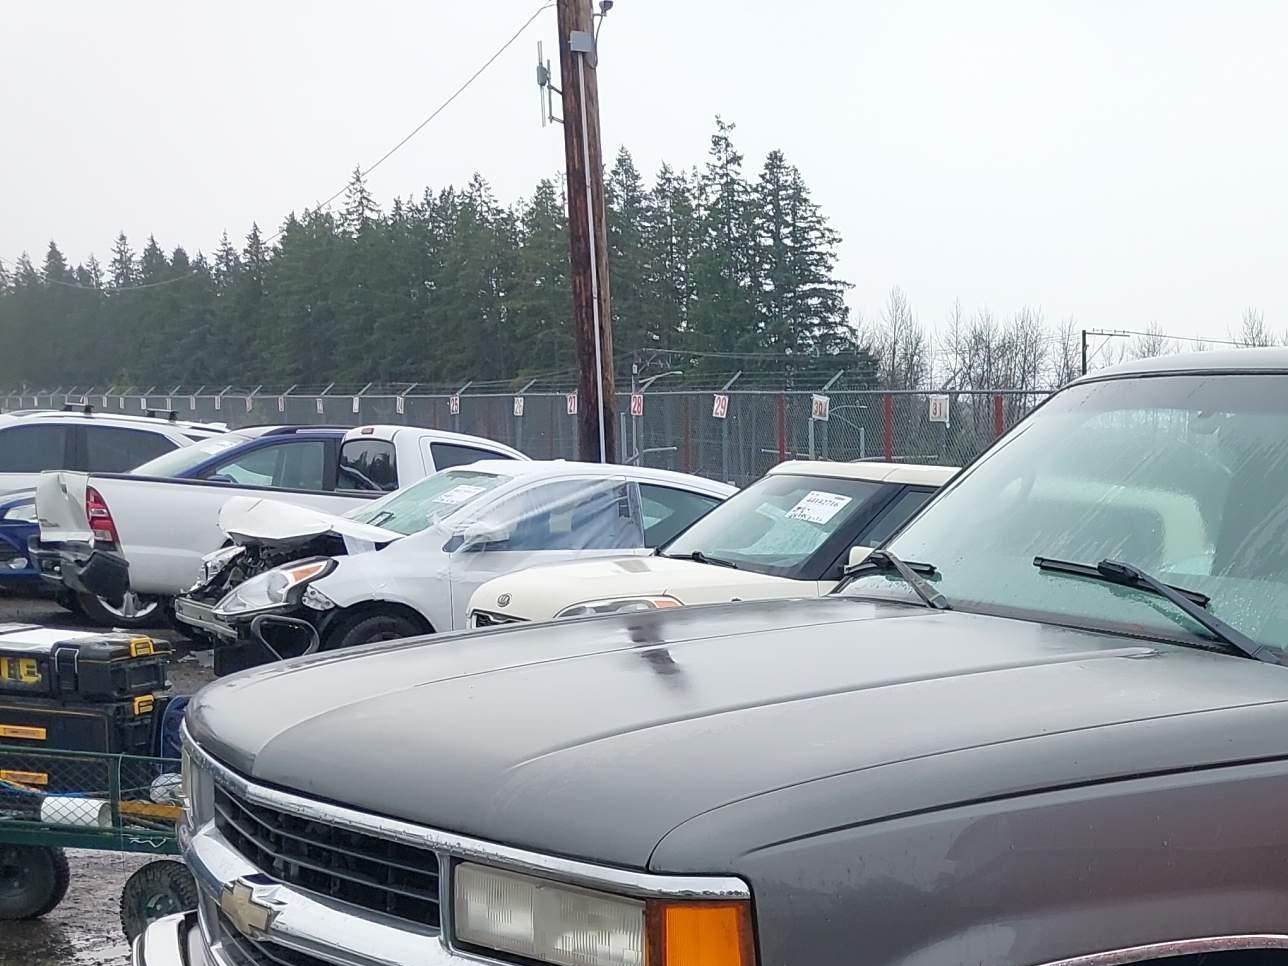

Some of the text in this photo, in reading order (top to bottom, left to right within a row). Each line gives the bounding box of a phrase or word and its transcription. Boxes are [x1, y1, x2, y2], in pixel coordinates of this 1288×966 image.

[632, 396, 642, 414] 28
[715, 396, 726, 416] 29
[933, 402, 942, 416] 31
